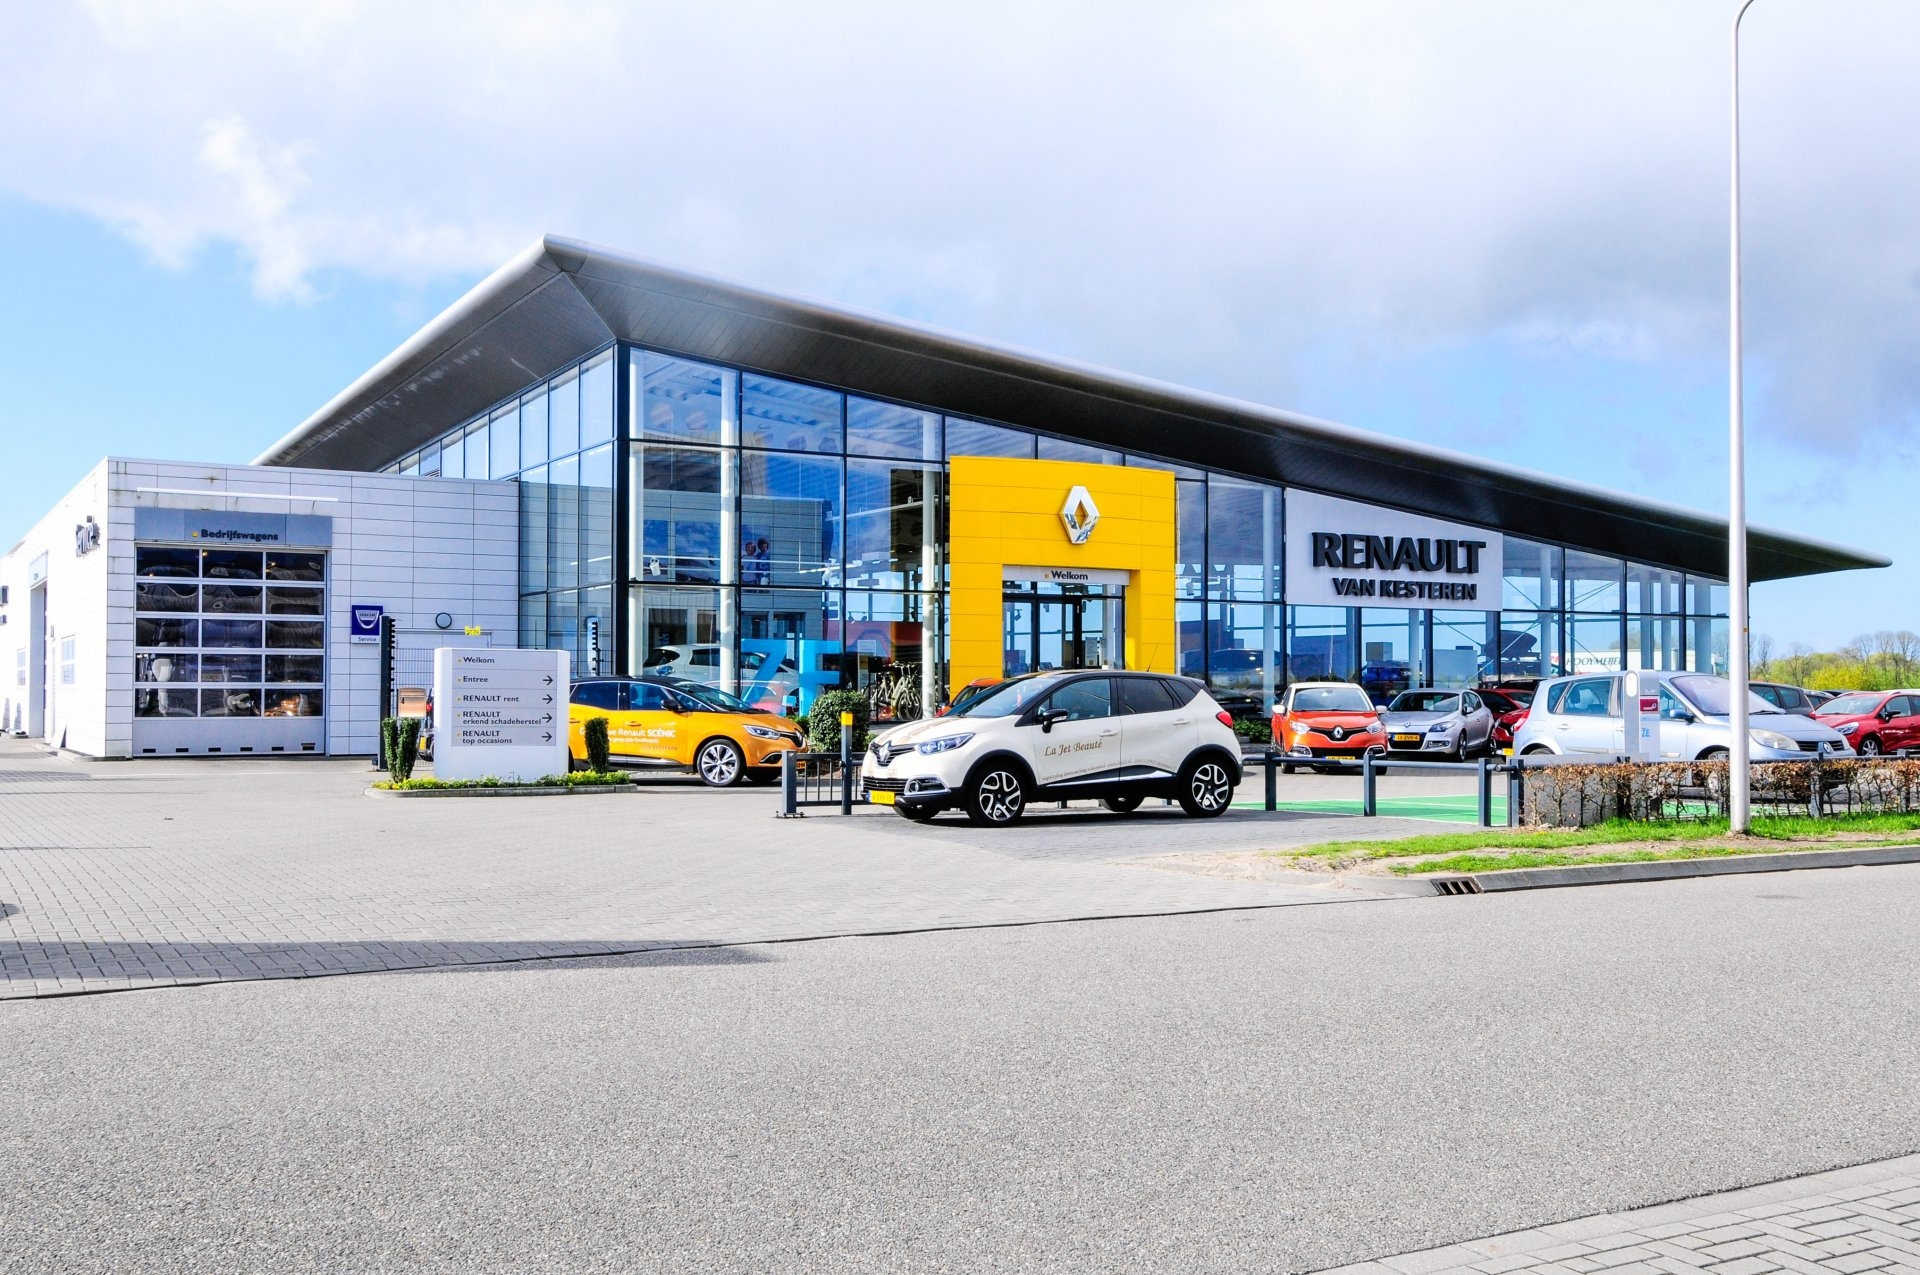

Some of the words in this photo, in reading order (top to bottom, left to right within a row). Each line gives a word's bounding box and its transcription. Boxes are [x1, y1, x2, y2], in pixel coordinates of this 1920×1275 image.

[201, 529, 278, 542] Bedrijfswagens
[1312, 532, 1486, 574] RENAULT
[1051, 570, 1089, 580] Welkom
[1332, 577, 1376, 597] VAN
[1379, 579, 1477, 600] KESTEREN
[463, 656, 495, 664] Welkom
[1566, 656, 1623, 666] HOOYMEIJE
[617, 728, 646, 736] Renault
[1044, 746, 1057, 756] La
[1057, 744, 1072, 756] Jet
[1072, 739, 1103, 752] Beauté
